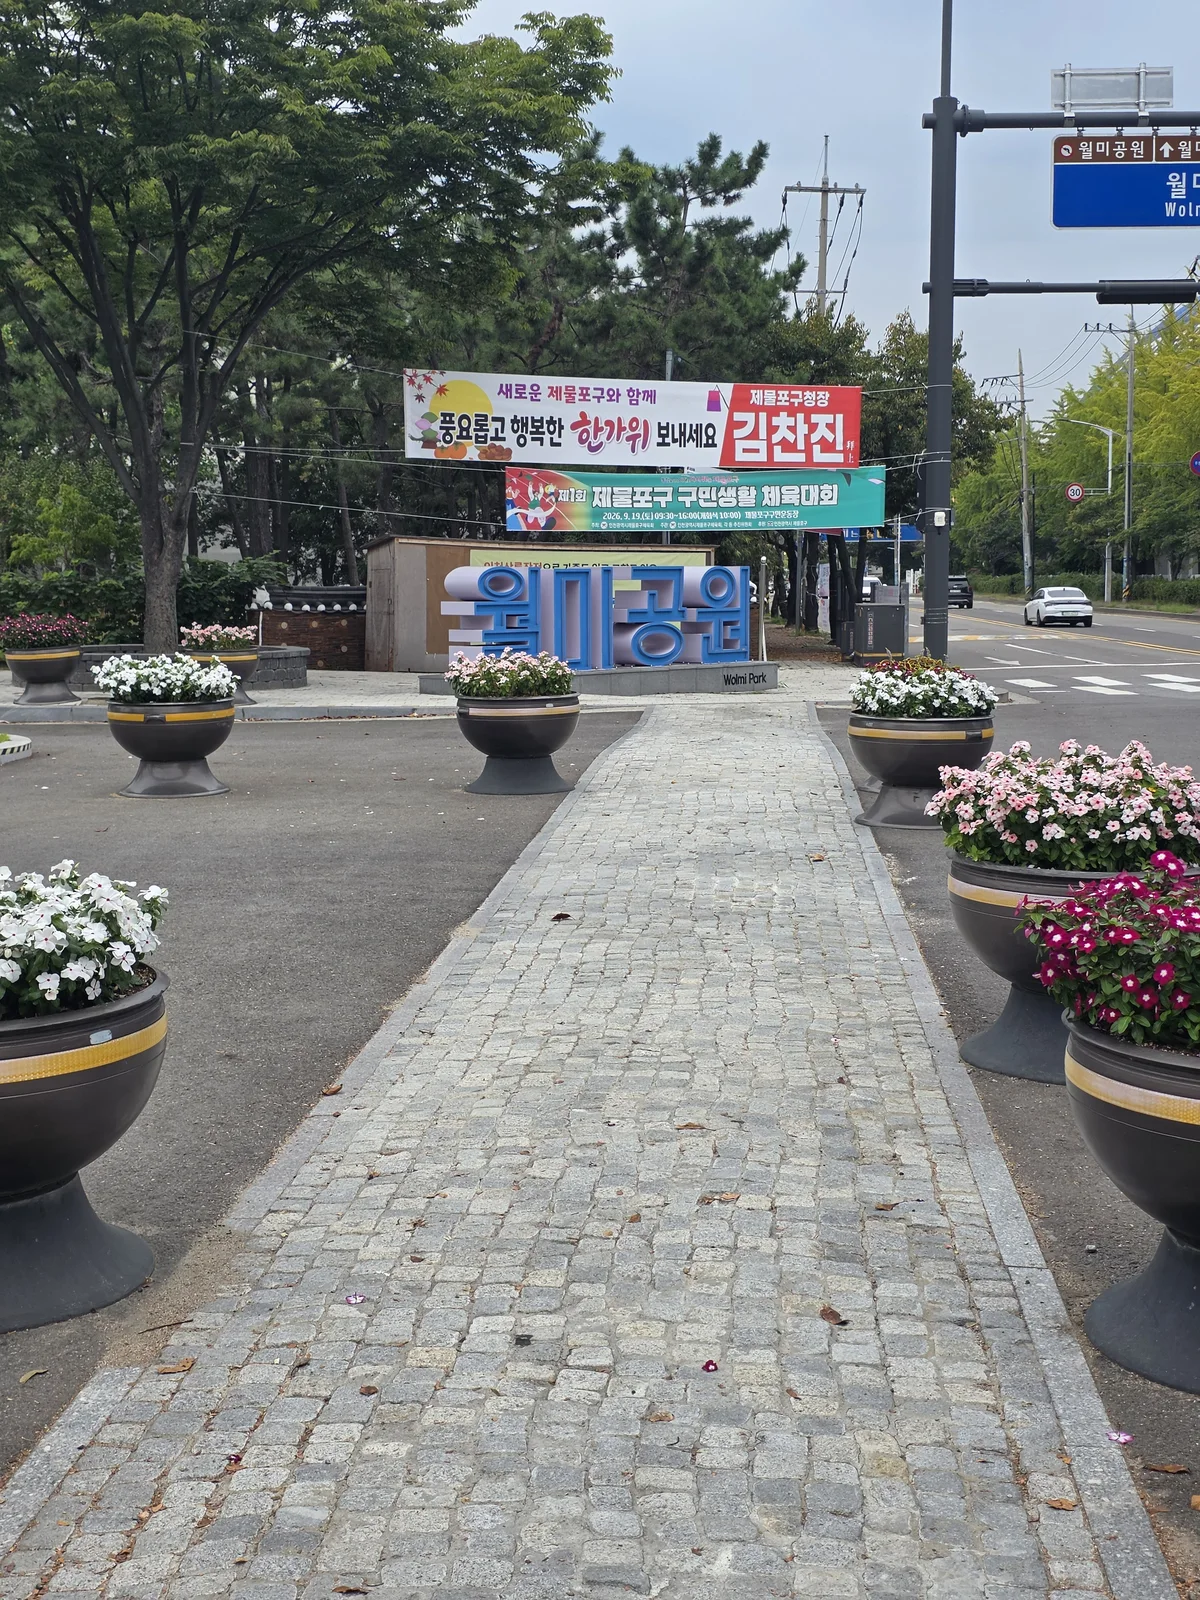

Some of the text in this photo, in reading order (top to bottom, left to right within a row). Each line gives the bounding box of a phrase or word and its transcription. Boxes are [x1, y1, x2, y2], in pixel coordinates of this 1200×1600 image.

[1079, 141, 1144, 159] 월미공원
[497, 383, 656, 406] 새로운 제물포구와 함께
[750, 389, 830, 407] 제물포구청장
[439, 411, 717, 453] 풍요롭고 행복한 한가위 보내세요
[733, 412, 844, 462] 김찬진
[558, 484, 838, 508] 제1회 제물포구 구민생활 체육대회
[1069, 488, 1081, 496] 30
[472, 565, 750, 670] 월미공원
[723, 672, 767, 686] Wolmi Park
